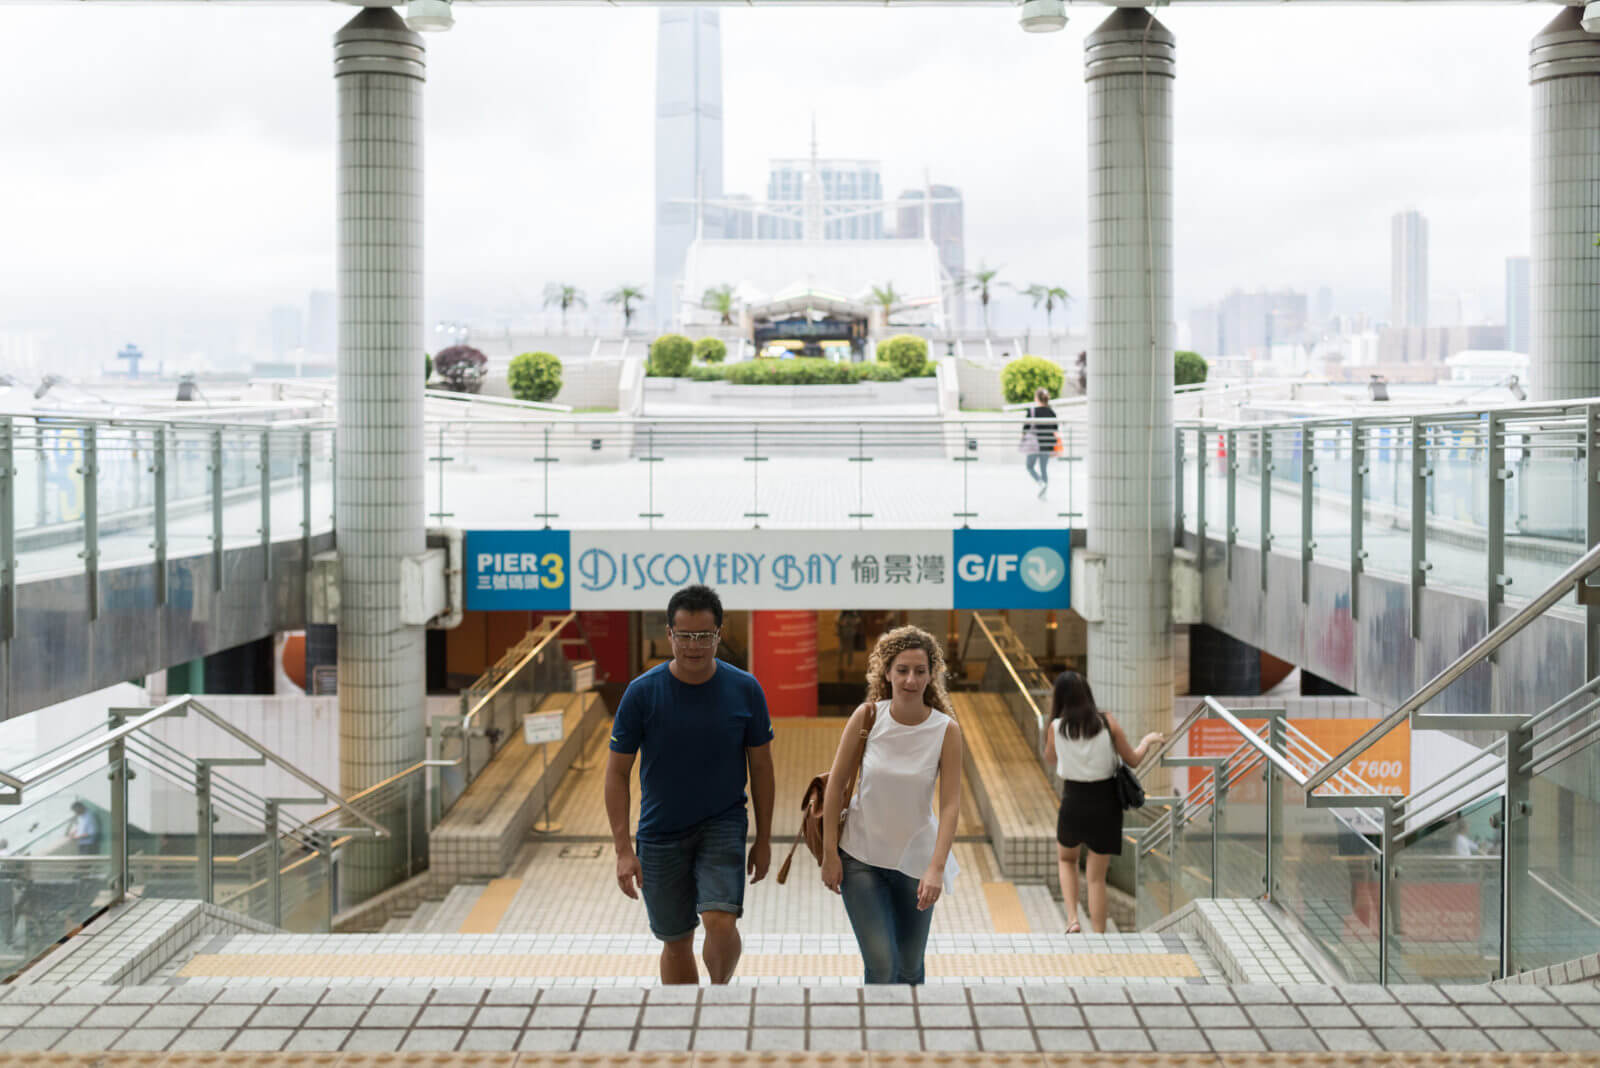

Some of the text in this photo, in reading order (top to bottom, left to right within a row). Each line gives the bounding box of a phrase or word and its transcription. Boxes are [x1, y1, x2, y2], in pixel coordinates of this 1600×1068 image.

[477, 552, 565, 590] PIER 3
[578, 548, 945, 591] DISCOVERY BAY 愉景灣
[957, 553, 1019, 582] G/F
[1357, 760, 1403, 779] 7600
